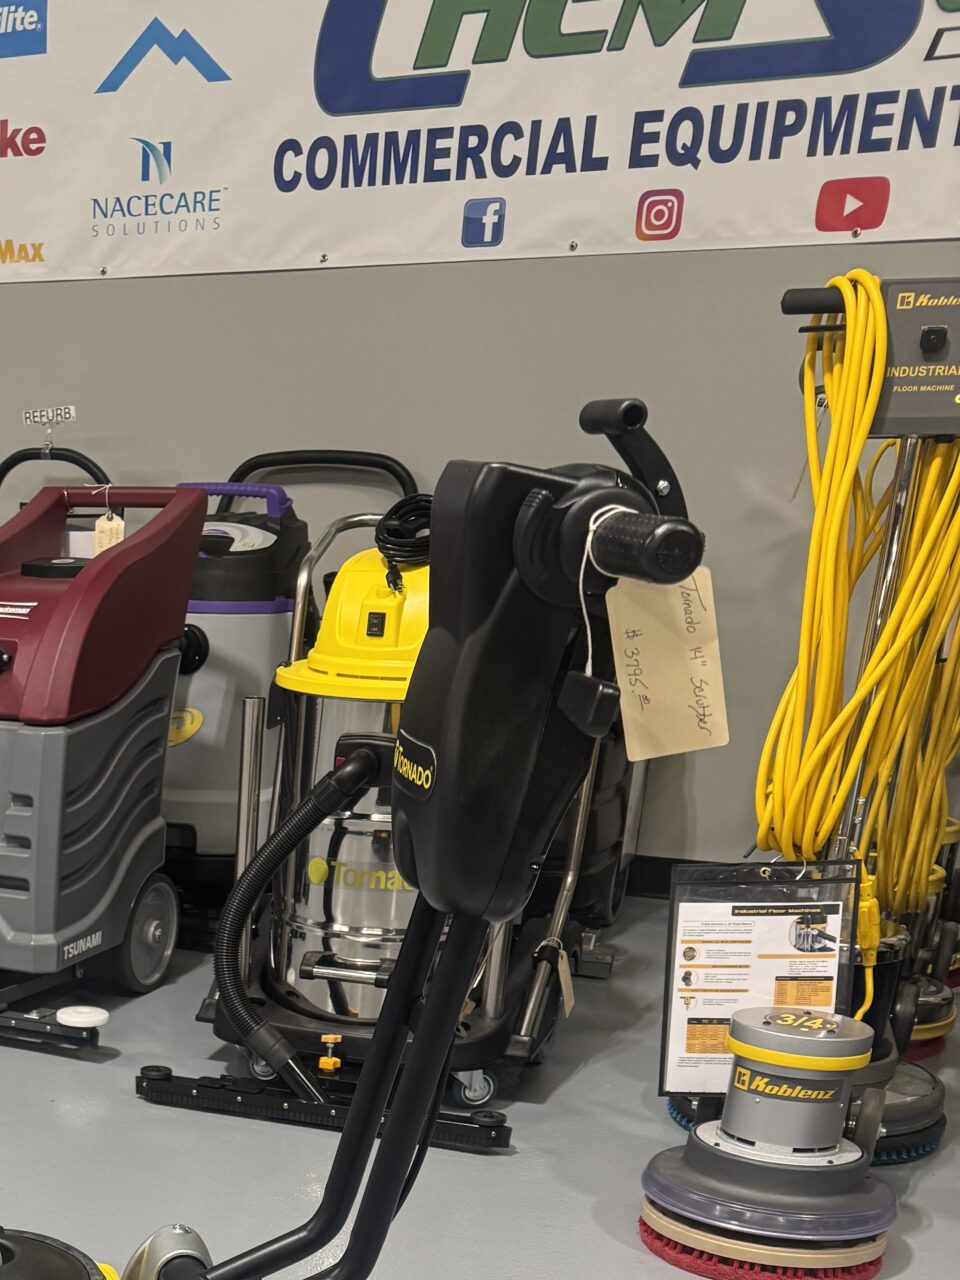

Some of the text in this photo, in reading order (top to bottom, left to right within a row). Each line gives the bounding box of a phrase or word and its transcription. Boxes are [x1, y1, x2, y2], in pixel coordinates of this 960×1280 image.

[273, 84, 960, 193] COMMERCIAL EQUIPMEN
[90, 189, 222, 220] NACECARE
[91, 216, 221, 238] SOLUTIONS
[893, 384, 956, 393] FLOOR MACHINE
[678, 574, 708, 635] Tornado
[397, 744, 432, 790] TORNADO
[63, 930, 103, 960] TSUNAMI
[750, 1076, 836, 1100] Koblenz
